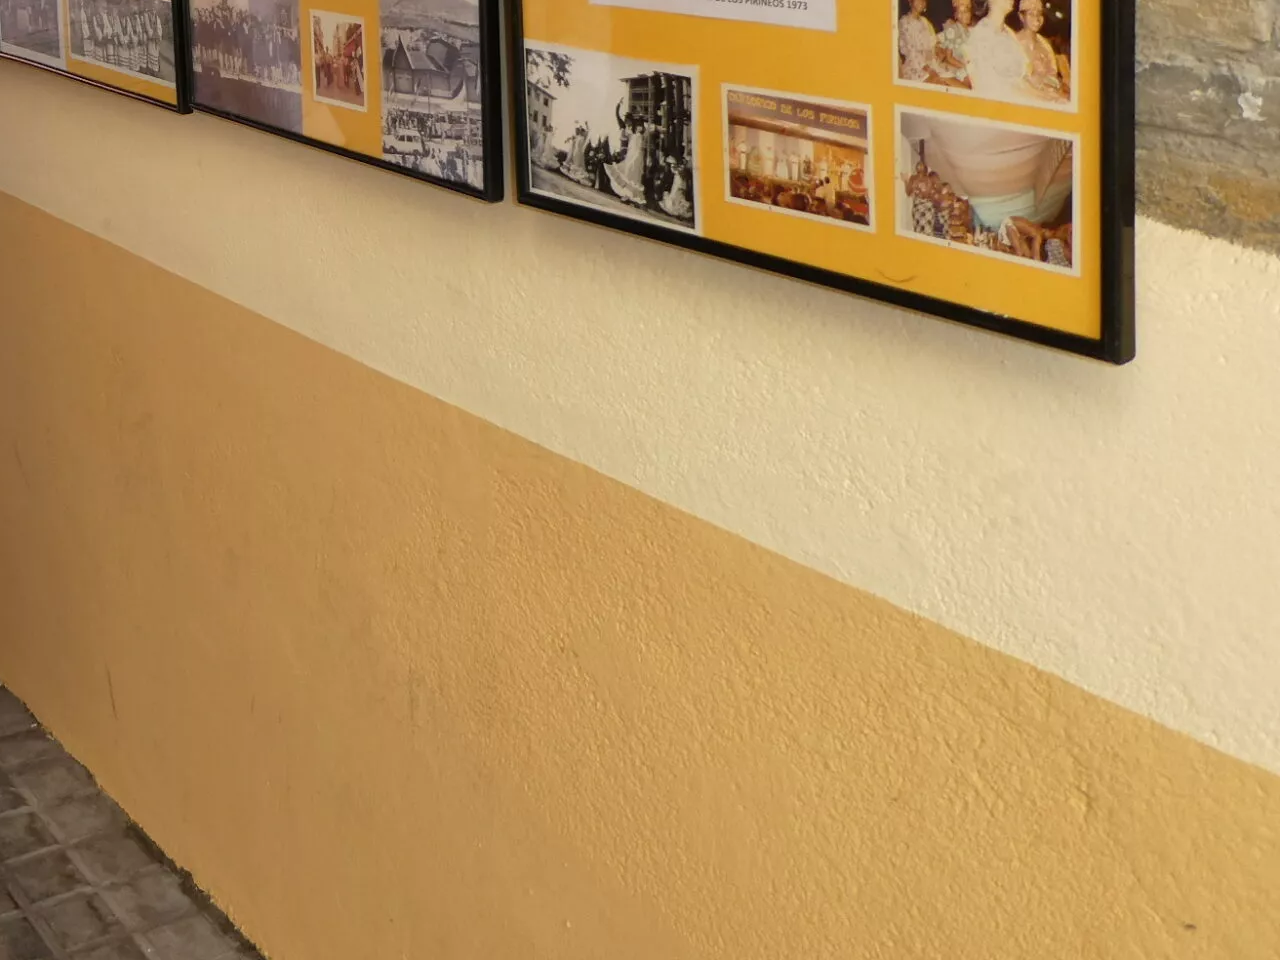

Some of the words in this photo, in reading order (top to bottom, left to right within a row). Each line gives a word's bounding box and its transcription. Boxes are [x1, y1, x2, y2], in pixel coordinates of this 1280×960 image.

[786, 0, 808, 11] 1973
[780, 103, 793, 116] DE
[796, 108, 815, 121] LOS
